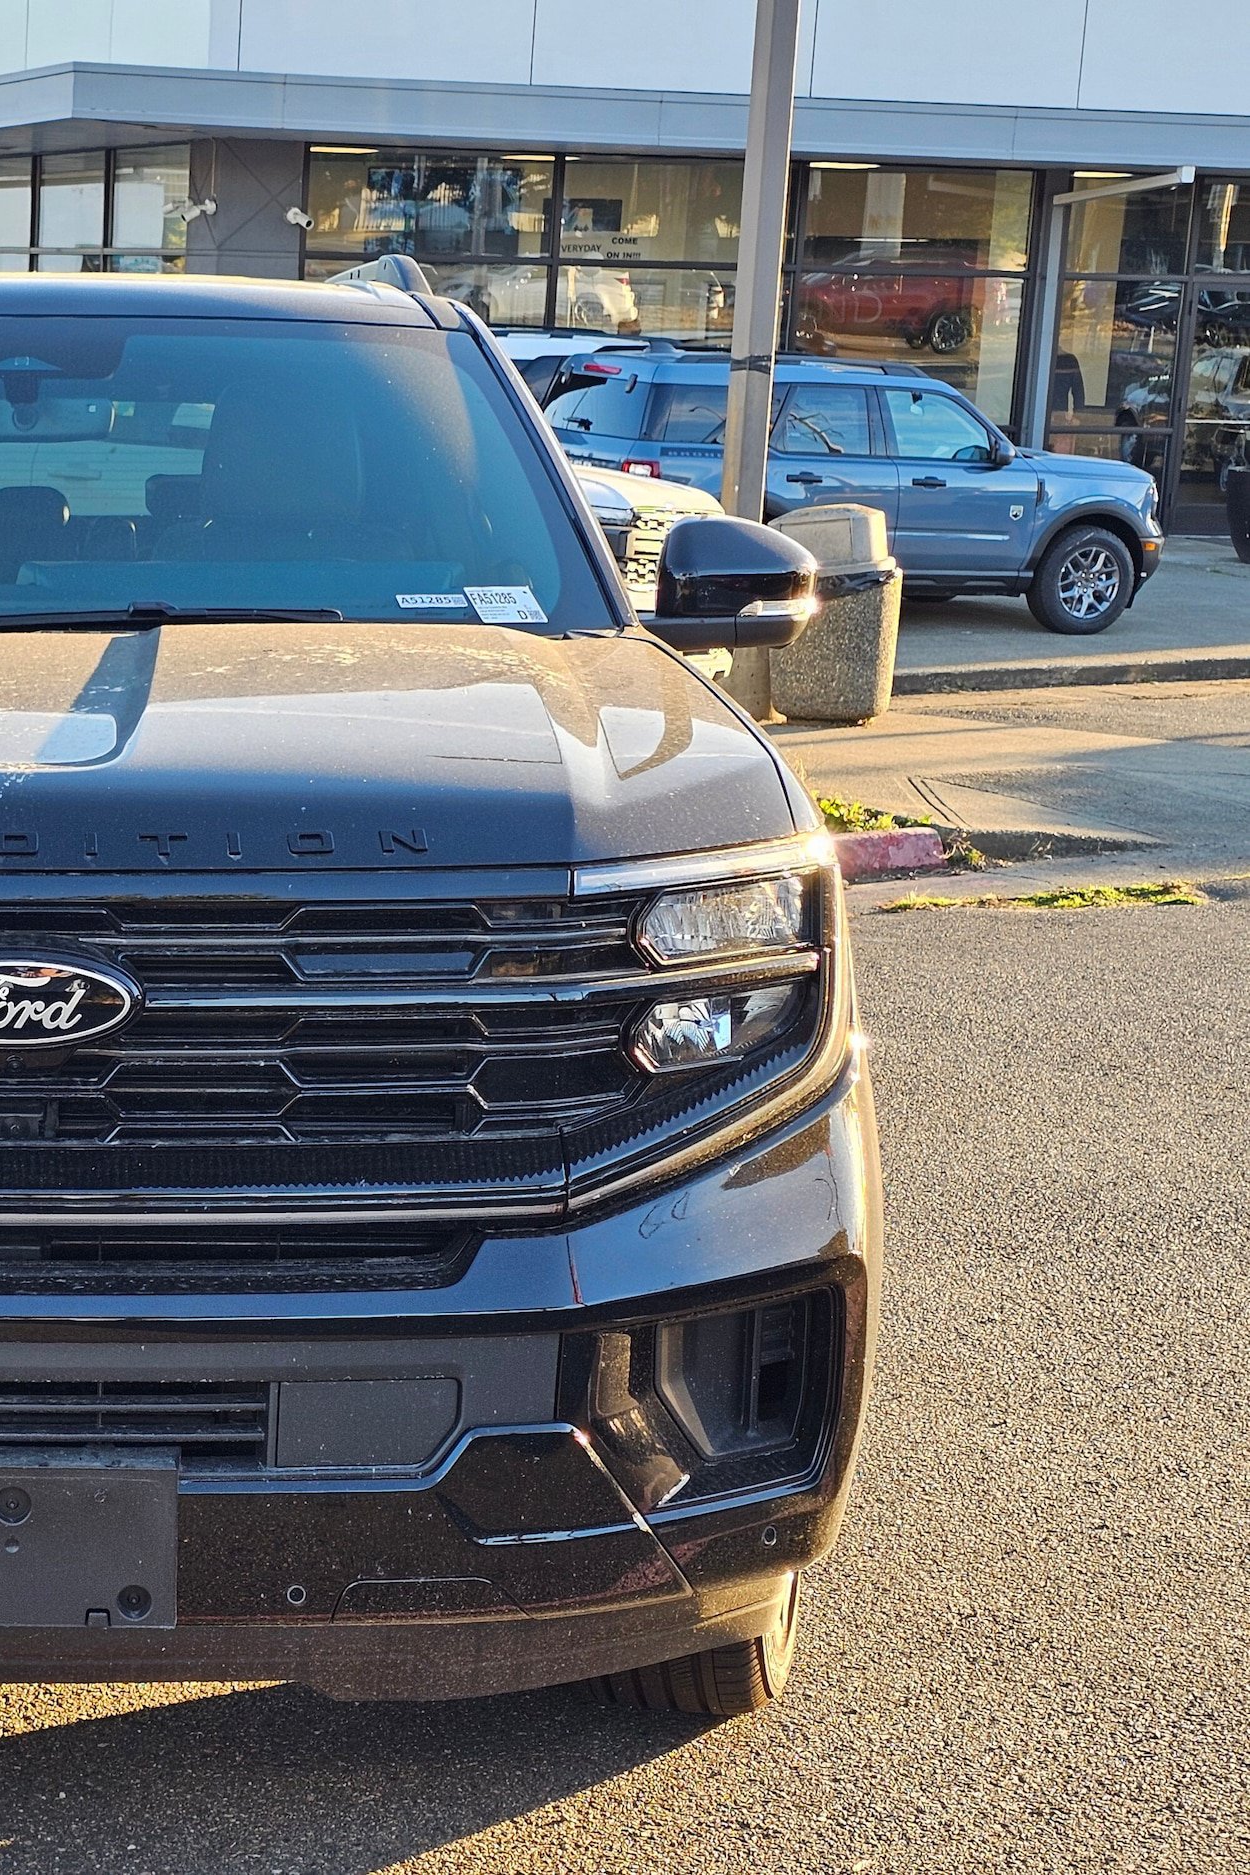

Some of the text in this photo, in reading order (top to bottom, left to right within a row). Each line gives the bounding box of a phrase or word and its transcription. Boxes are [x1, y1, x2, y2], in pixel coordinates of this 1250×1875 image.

[611, 237, 638, 245] COME
[606, 251, 620, 259] ON
[401, 596, 452, 605] A51285
[469, 592, 517, 605] FA51285
[517, 610, 528, 620] D
